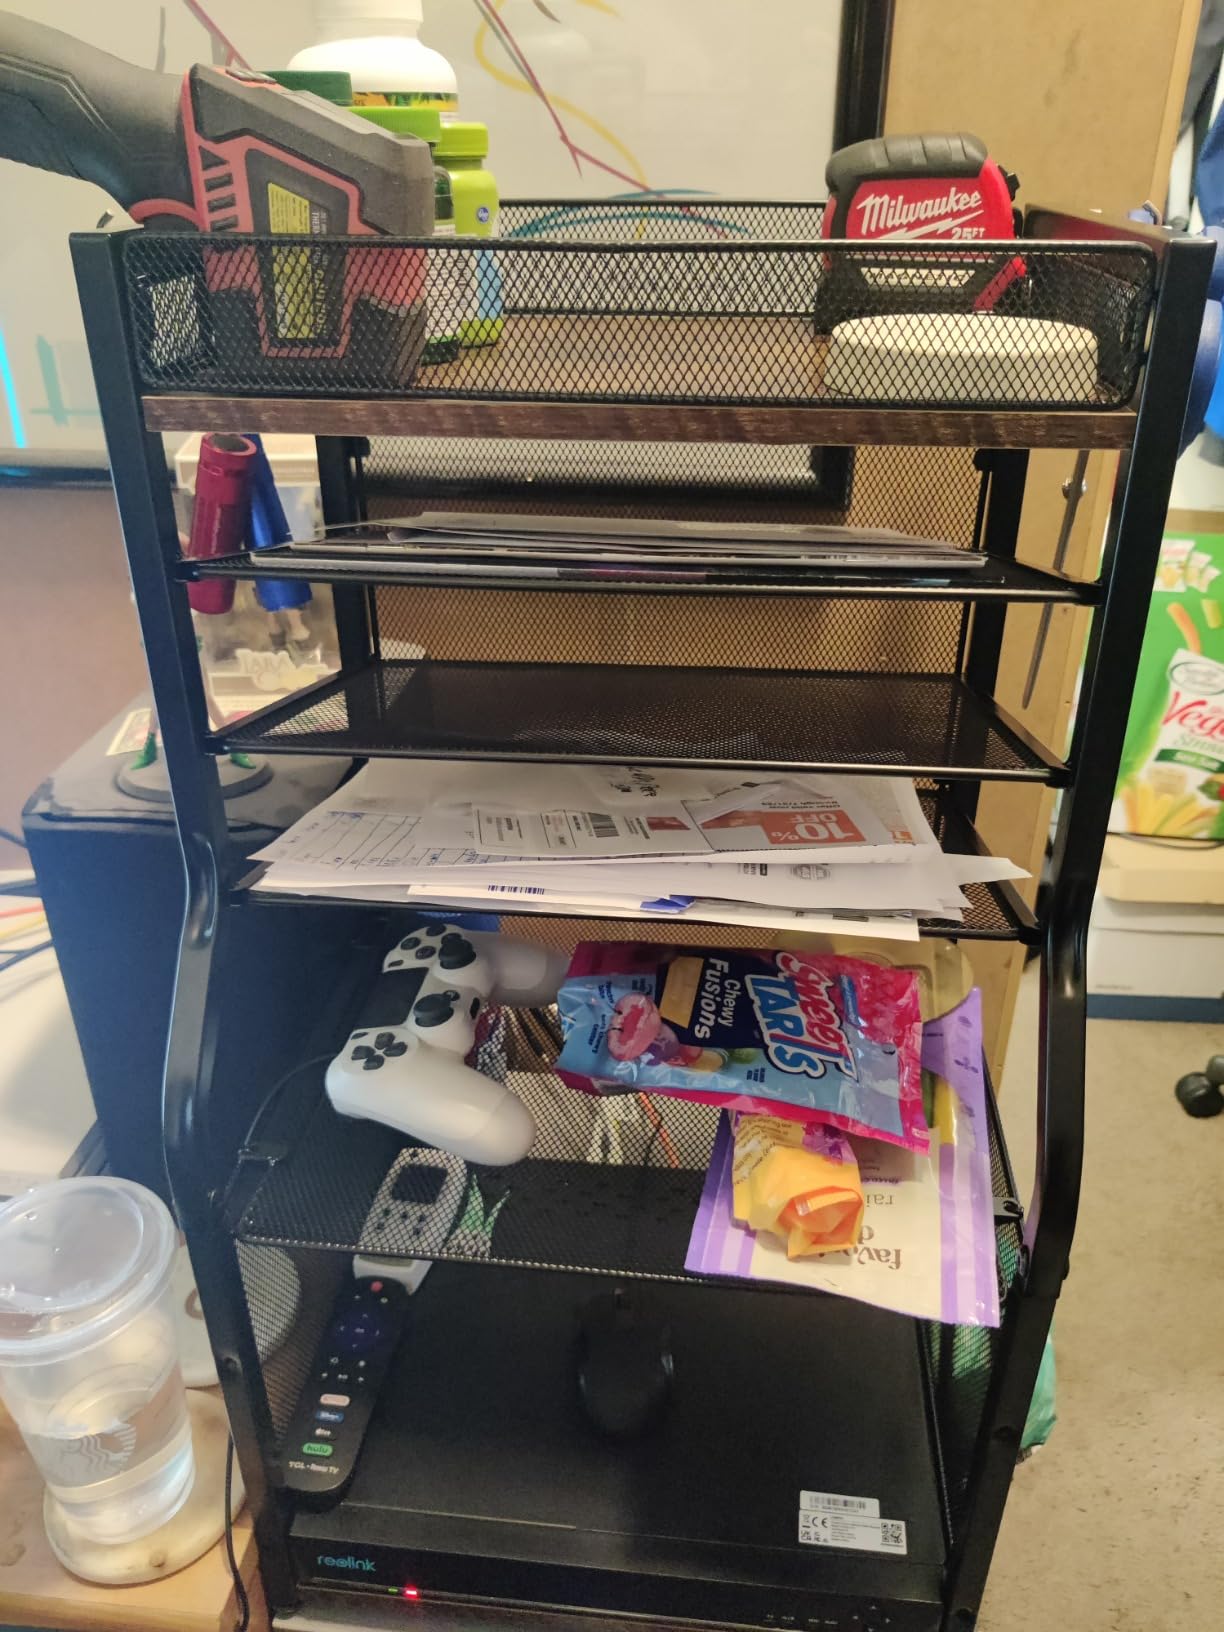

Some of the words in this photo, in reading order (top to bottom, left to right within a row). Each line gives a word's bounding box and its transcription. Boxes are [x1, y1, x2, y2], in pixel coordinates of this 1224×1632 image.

[856, 187, 982, 236] Milwaukee
[789, 812, 837, 824] OFF
[771, 822, 854, 842] 10%
[694, 957, 729, 1040] Fusions
[719, 979, 741, 1027] Chewy
[866, 1194, 893, 1207] rai
[857, 1225, 875, 1246] d
[306, 1444, 329, 1454] hulu
[288, 1460, 305, 1469] TCL
[316, 1554, 377, 1572] reolink
